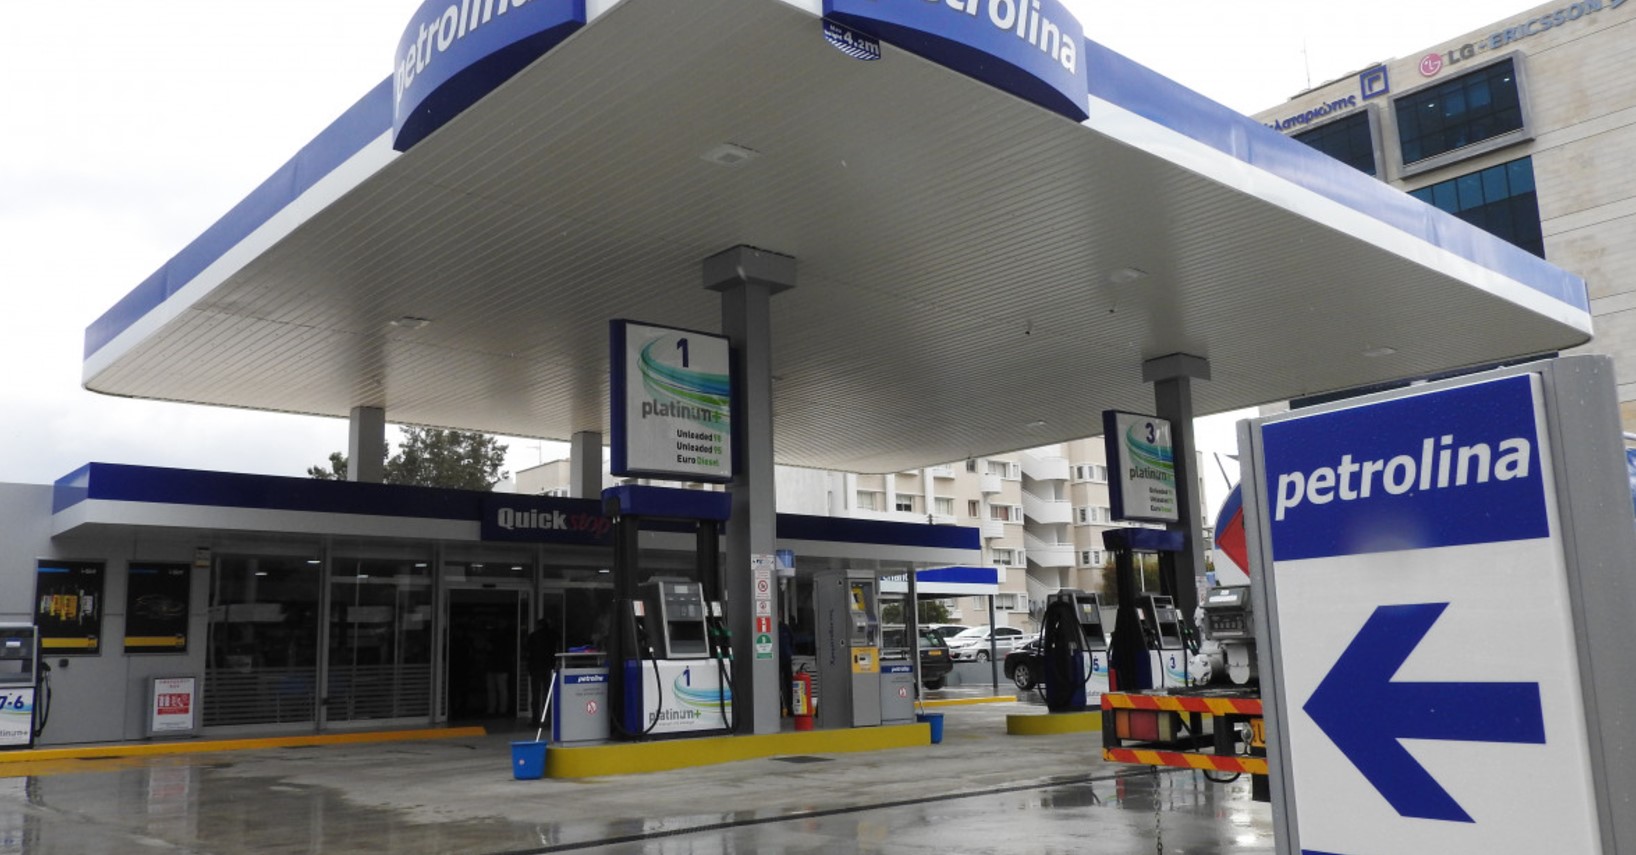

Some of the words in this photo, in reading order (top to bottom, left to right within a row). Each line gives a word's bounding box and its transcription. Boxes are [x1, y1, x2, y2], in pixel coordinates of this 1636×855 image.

[843, 31, 879, 55] 4.2m
[395, 0, 527, 118] petrolin
[677, 338, 689, 368] 1
[676, 429, 713, 442] Unleaded
[1145, 422, 1155, 445] 3
[676, 441, 713, 454] Unleaded
[677, 454, 696, 464] Euro
[697, 456, 720, 467] Diesel
[1275, 434, 1531, 521] petrolina
[497, 507, 568, 530] Quick
[569, 512, 611, 535] stop
[1093, 658, 1100, 672] 5
[1169, 656, 1176, 669] 3
[682, 668, 691, 687] 1
